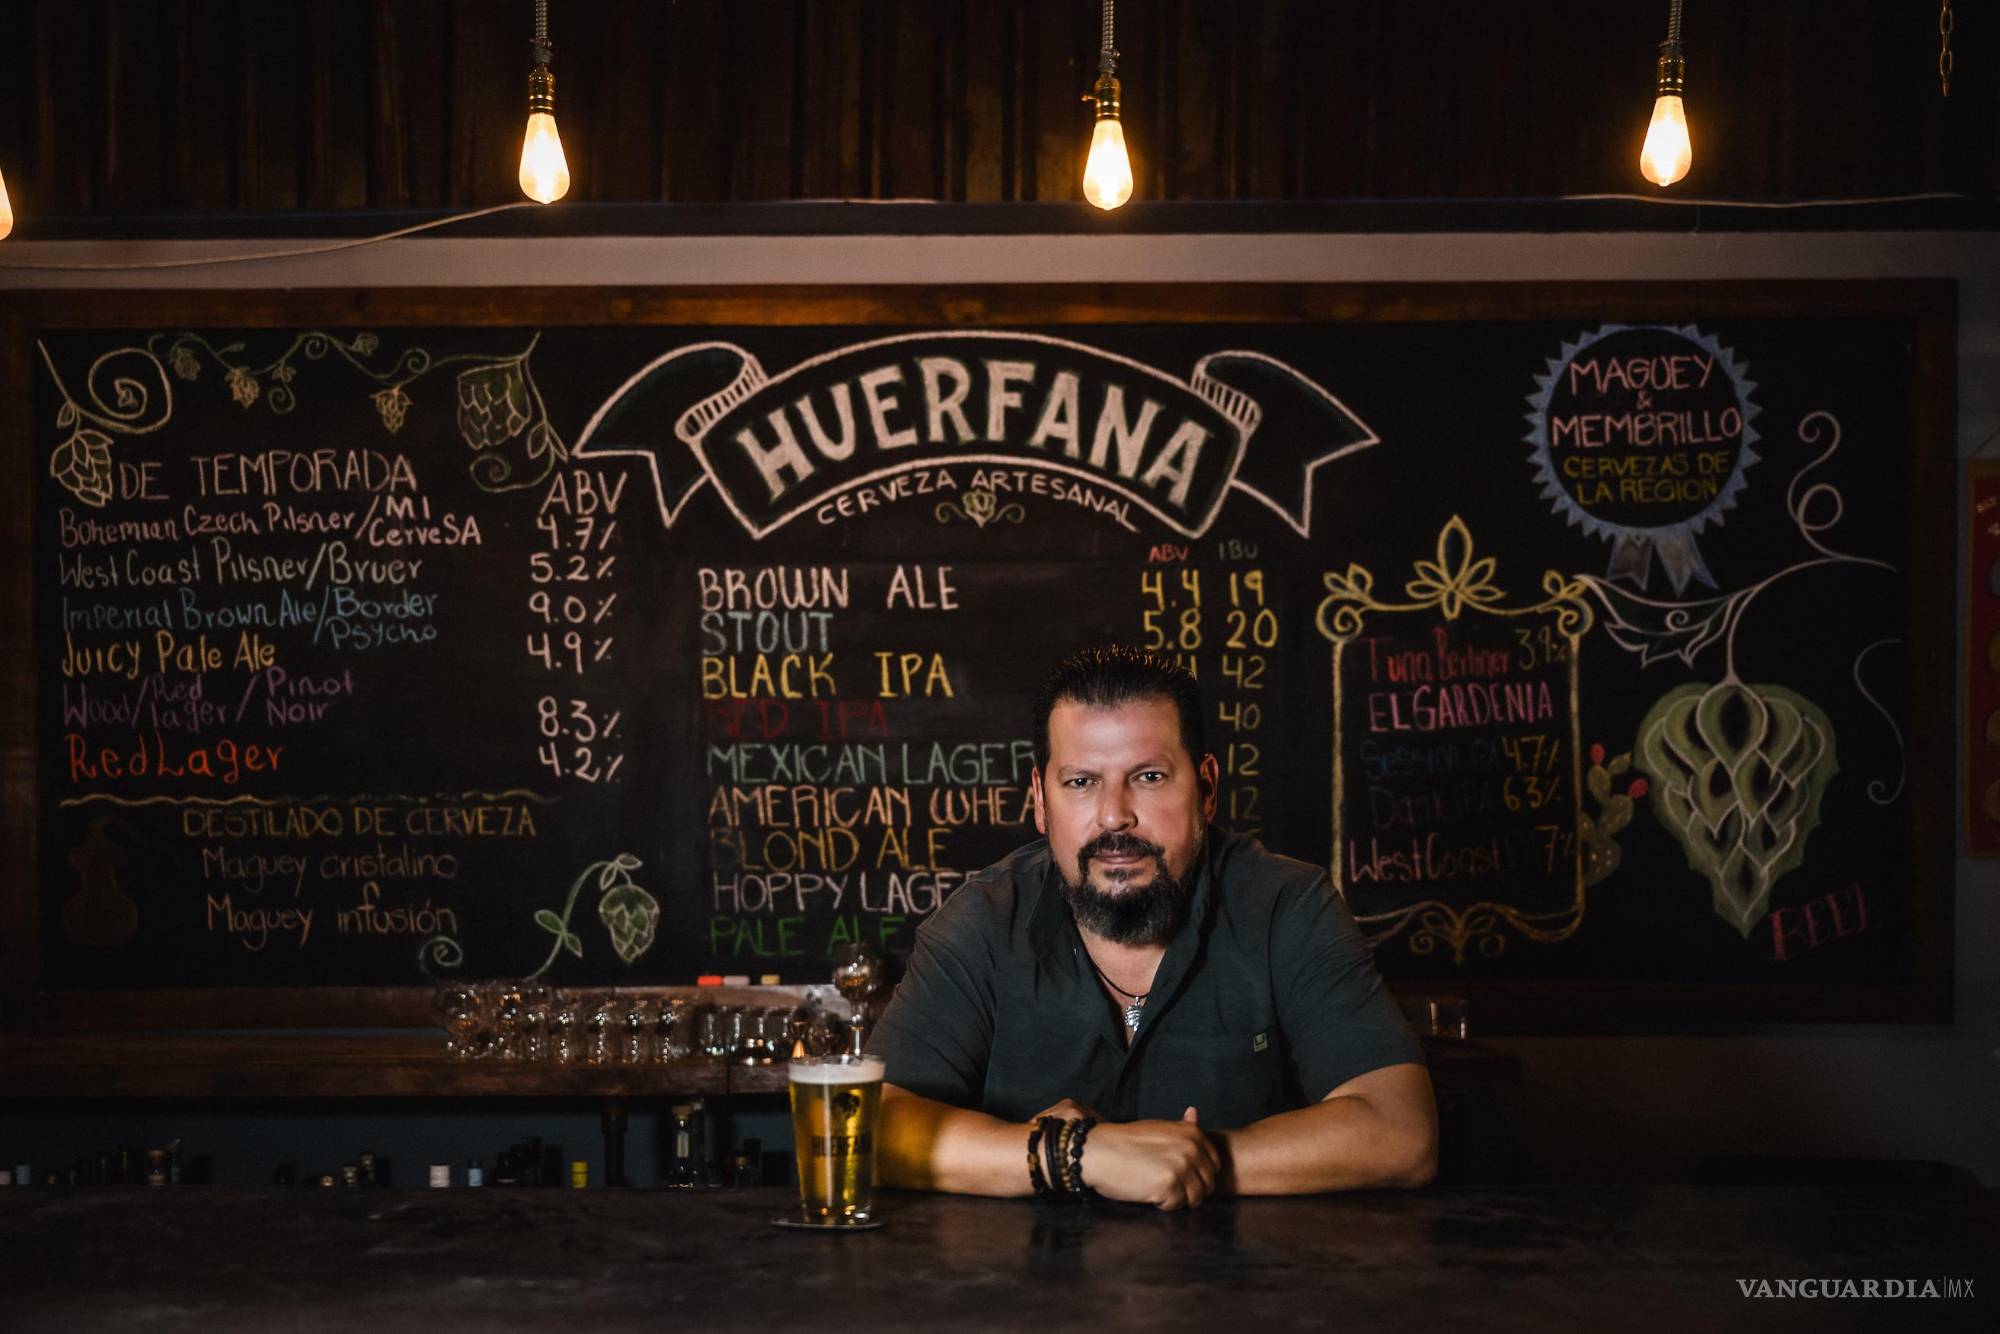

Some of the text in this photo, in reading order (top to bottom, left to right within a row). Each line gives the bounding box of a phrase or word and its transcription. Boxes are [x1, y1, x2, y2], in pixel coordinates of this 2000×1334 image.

[1570, 354, 1714, 396] MAGUEY
[1636, 389, 1654, 411] &
[735, 356, 1215, 510] HUERFANA
[1552, 407, 1743, 448] MEMBRILLO
[119, 448, 417, 500] DE TEMPORADA
[1563, 450, 1731, 479] CERVEZAS DE
[538, 469, 628, 516] ABV
[816, 468, 1142, 533] CERVEZA ARTESANAL
[1575, 477, 1717, 507] LA REGION
[59, 506, 179, 549] Bohemian
[184, 504, 262, 537] Czech
[385, 494, 431, 521] MI
[368, 512, 483, 547] CerveSA
[536, 513, 618, 551] 4.7%
[530, 552, 616, 583] 5.2%
[1148, 539, 1258, 563] ABV IBU
[63, 594, 174, 632] Imperial
[178, 586, 276, 631] Brown
[331, 585, 439, 620] Border
[528, 590, 618, 625] 9.0%
[697, 564, 960, 612] BROWN ALE
[1141, 567, 1264, 612] 4.4 19
[324, 614, 438, 652] Psycho
[700, 610, 834, 656] STOUT
[1142, 608, 1280, 650] 5.8 20
[61, 627, 276, 681] Juicy Pale Ale
[526, 630, 614, 675] 4.9%
[1221, 654, 1266, 690] 42
[265, 665, 355, 697] Pinot
[701, 651, 955, 699] BLACK IPA
[266, 700, 331, 727] Noir
[537, 695, 622, 744] 8.3%
[1218, 701, 1262, 732] 40
[538, 740, 625, 784] 4.2%
[706, 743, 888, 786] MEXICAN
[1227, 743, 1262, 776] 12
[182, 803, 538, 839] DESTILADO DE CERVEZA
[706, 785, 1036, 830] AMERICAN WHEA
[1230, 785, 1264, 820] 12
[202, 843, 459, 897] Maguey cristalino
[708, 827, 955, 873] BLOND ALE
[712, 871, 849, 914] HOPPY
[206, 880, 458, 948] Maguey infusión
[707, 916, 806, 958] PALE
